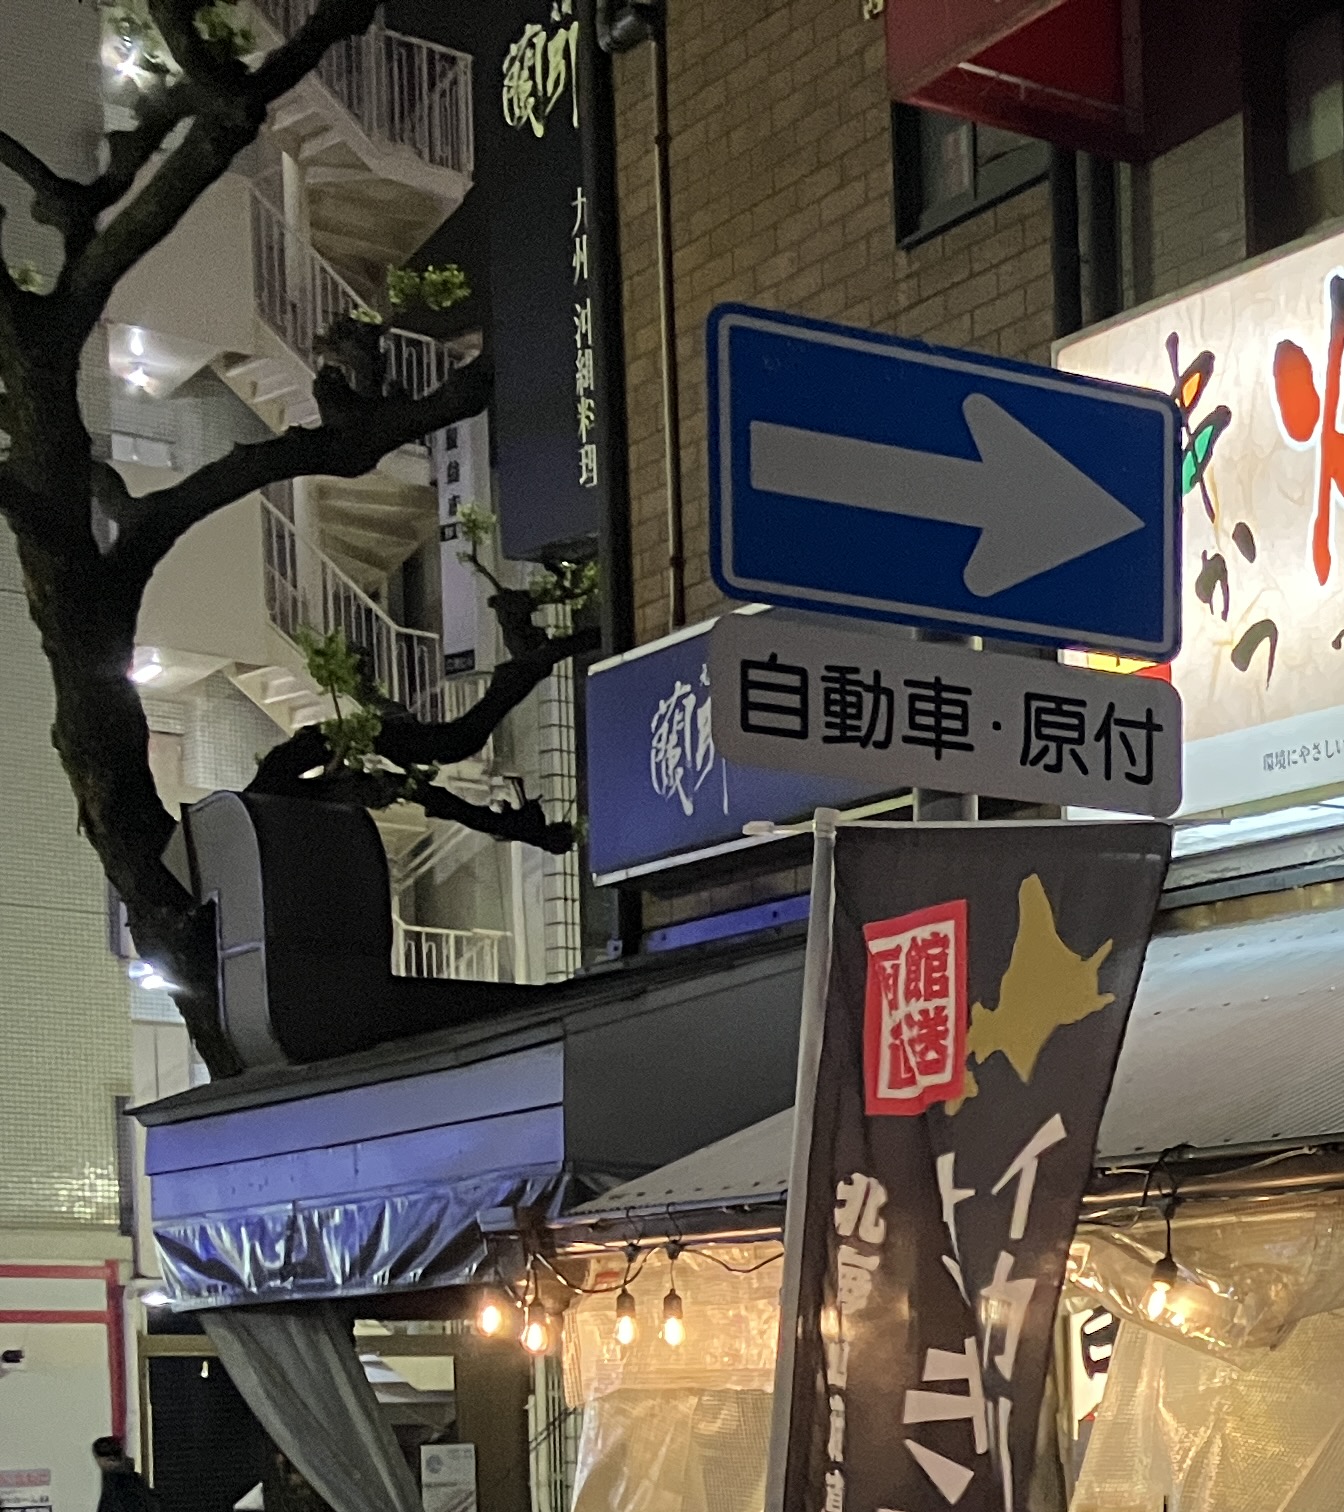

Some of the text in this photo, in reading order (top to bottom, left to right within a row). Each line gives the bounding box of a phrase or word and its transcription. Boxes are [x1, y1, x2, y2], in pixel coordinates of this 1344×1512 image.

[738, 652, 1164, 786] 自動車・原付
